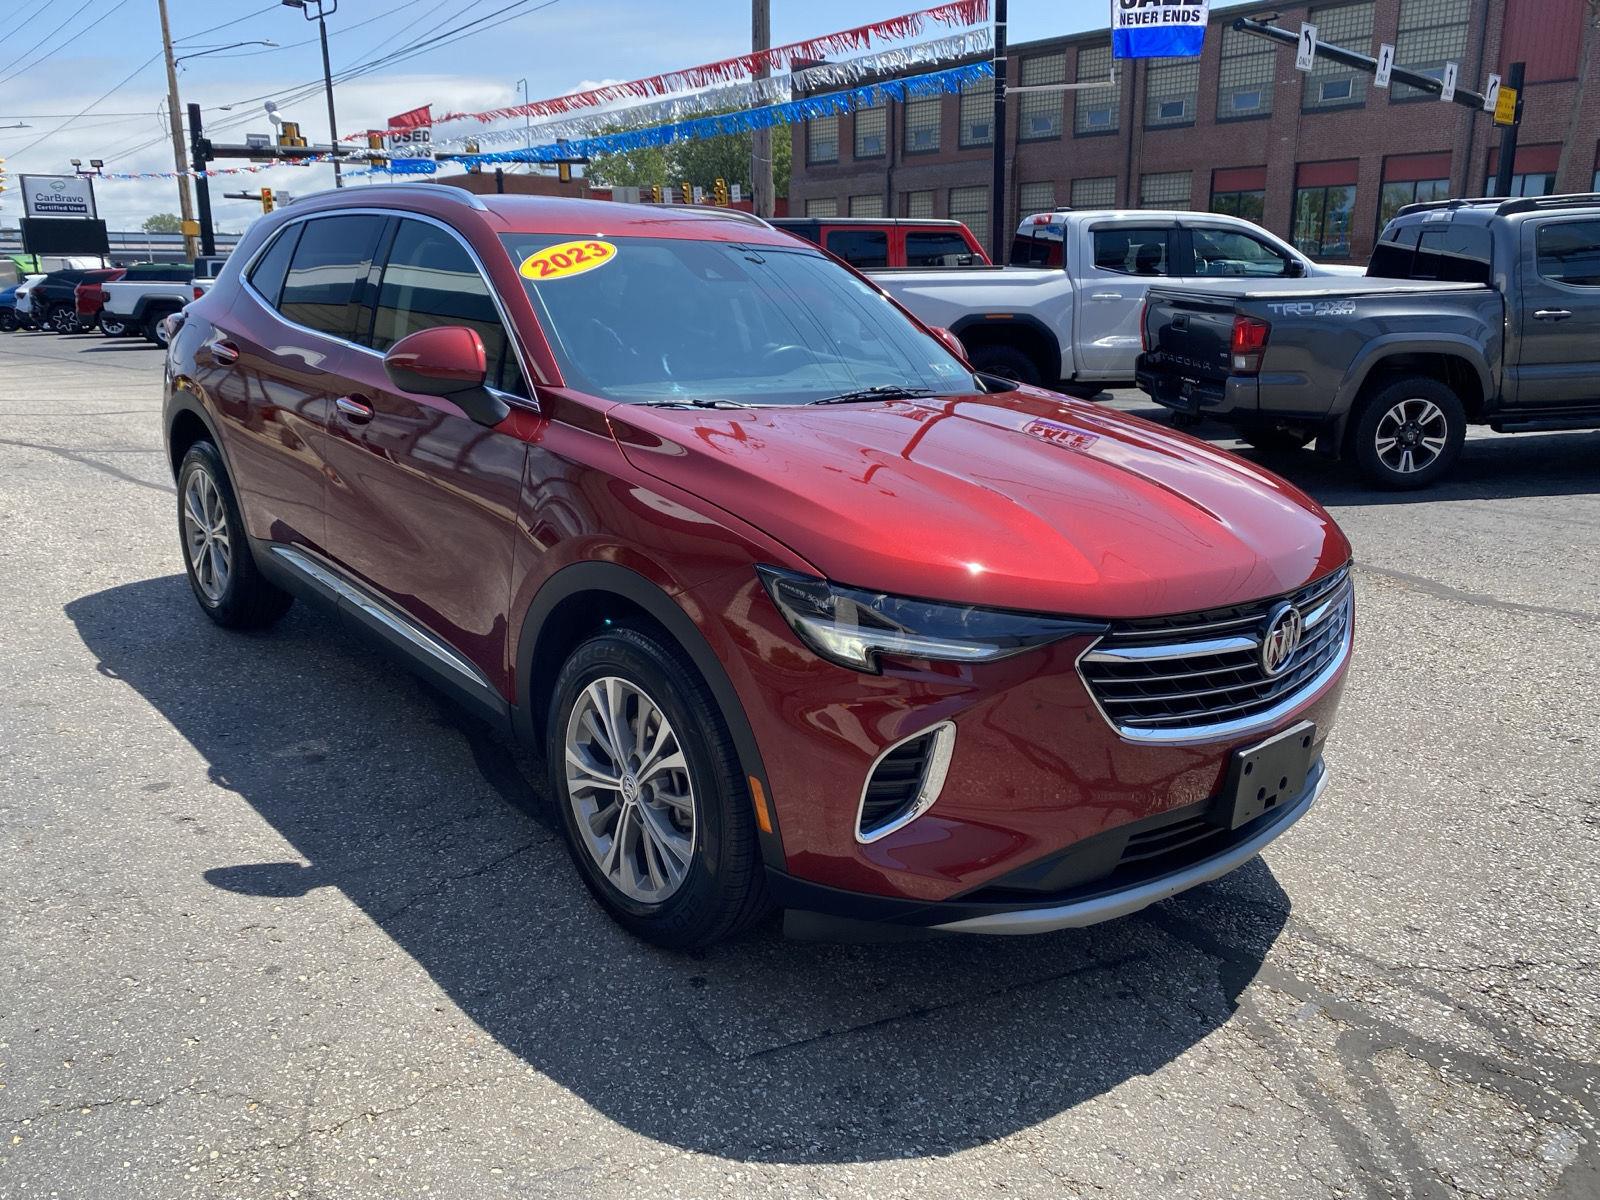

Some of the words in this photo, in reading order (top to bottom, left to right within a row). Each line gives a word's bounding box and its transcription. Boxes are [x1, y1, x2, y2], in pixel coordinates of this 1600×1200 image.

[1120, 11, 1158, 25] NEVER
[1163, 10, 1200, 22] ENDS
[35, 193, 84, 202] CarBravo
[531, 243, 607, 277] 2023
[1267, 302, 1314, 316] TRD
